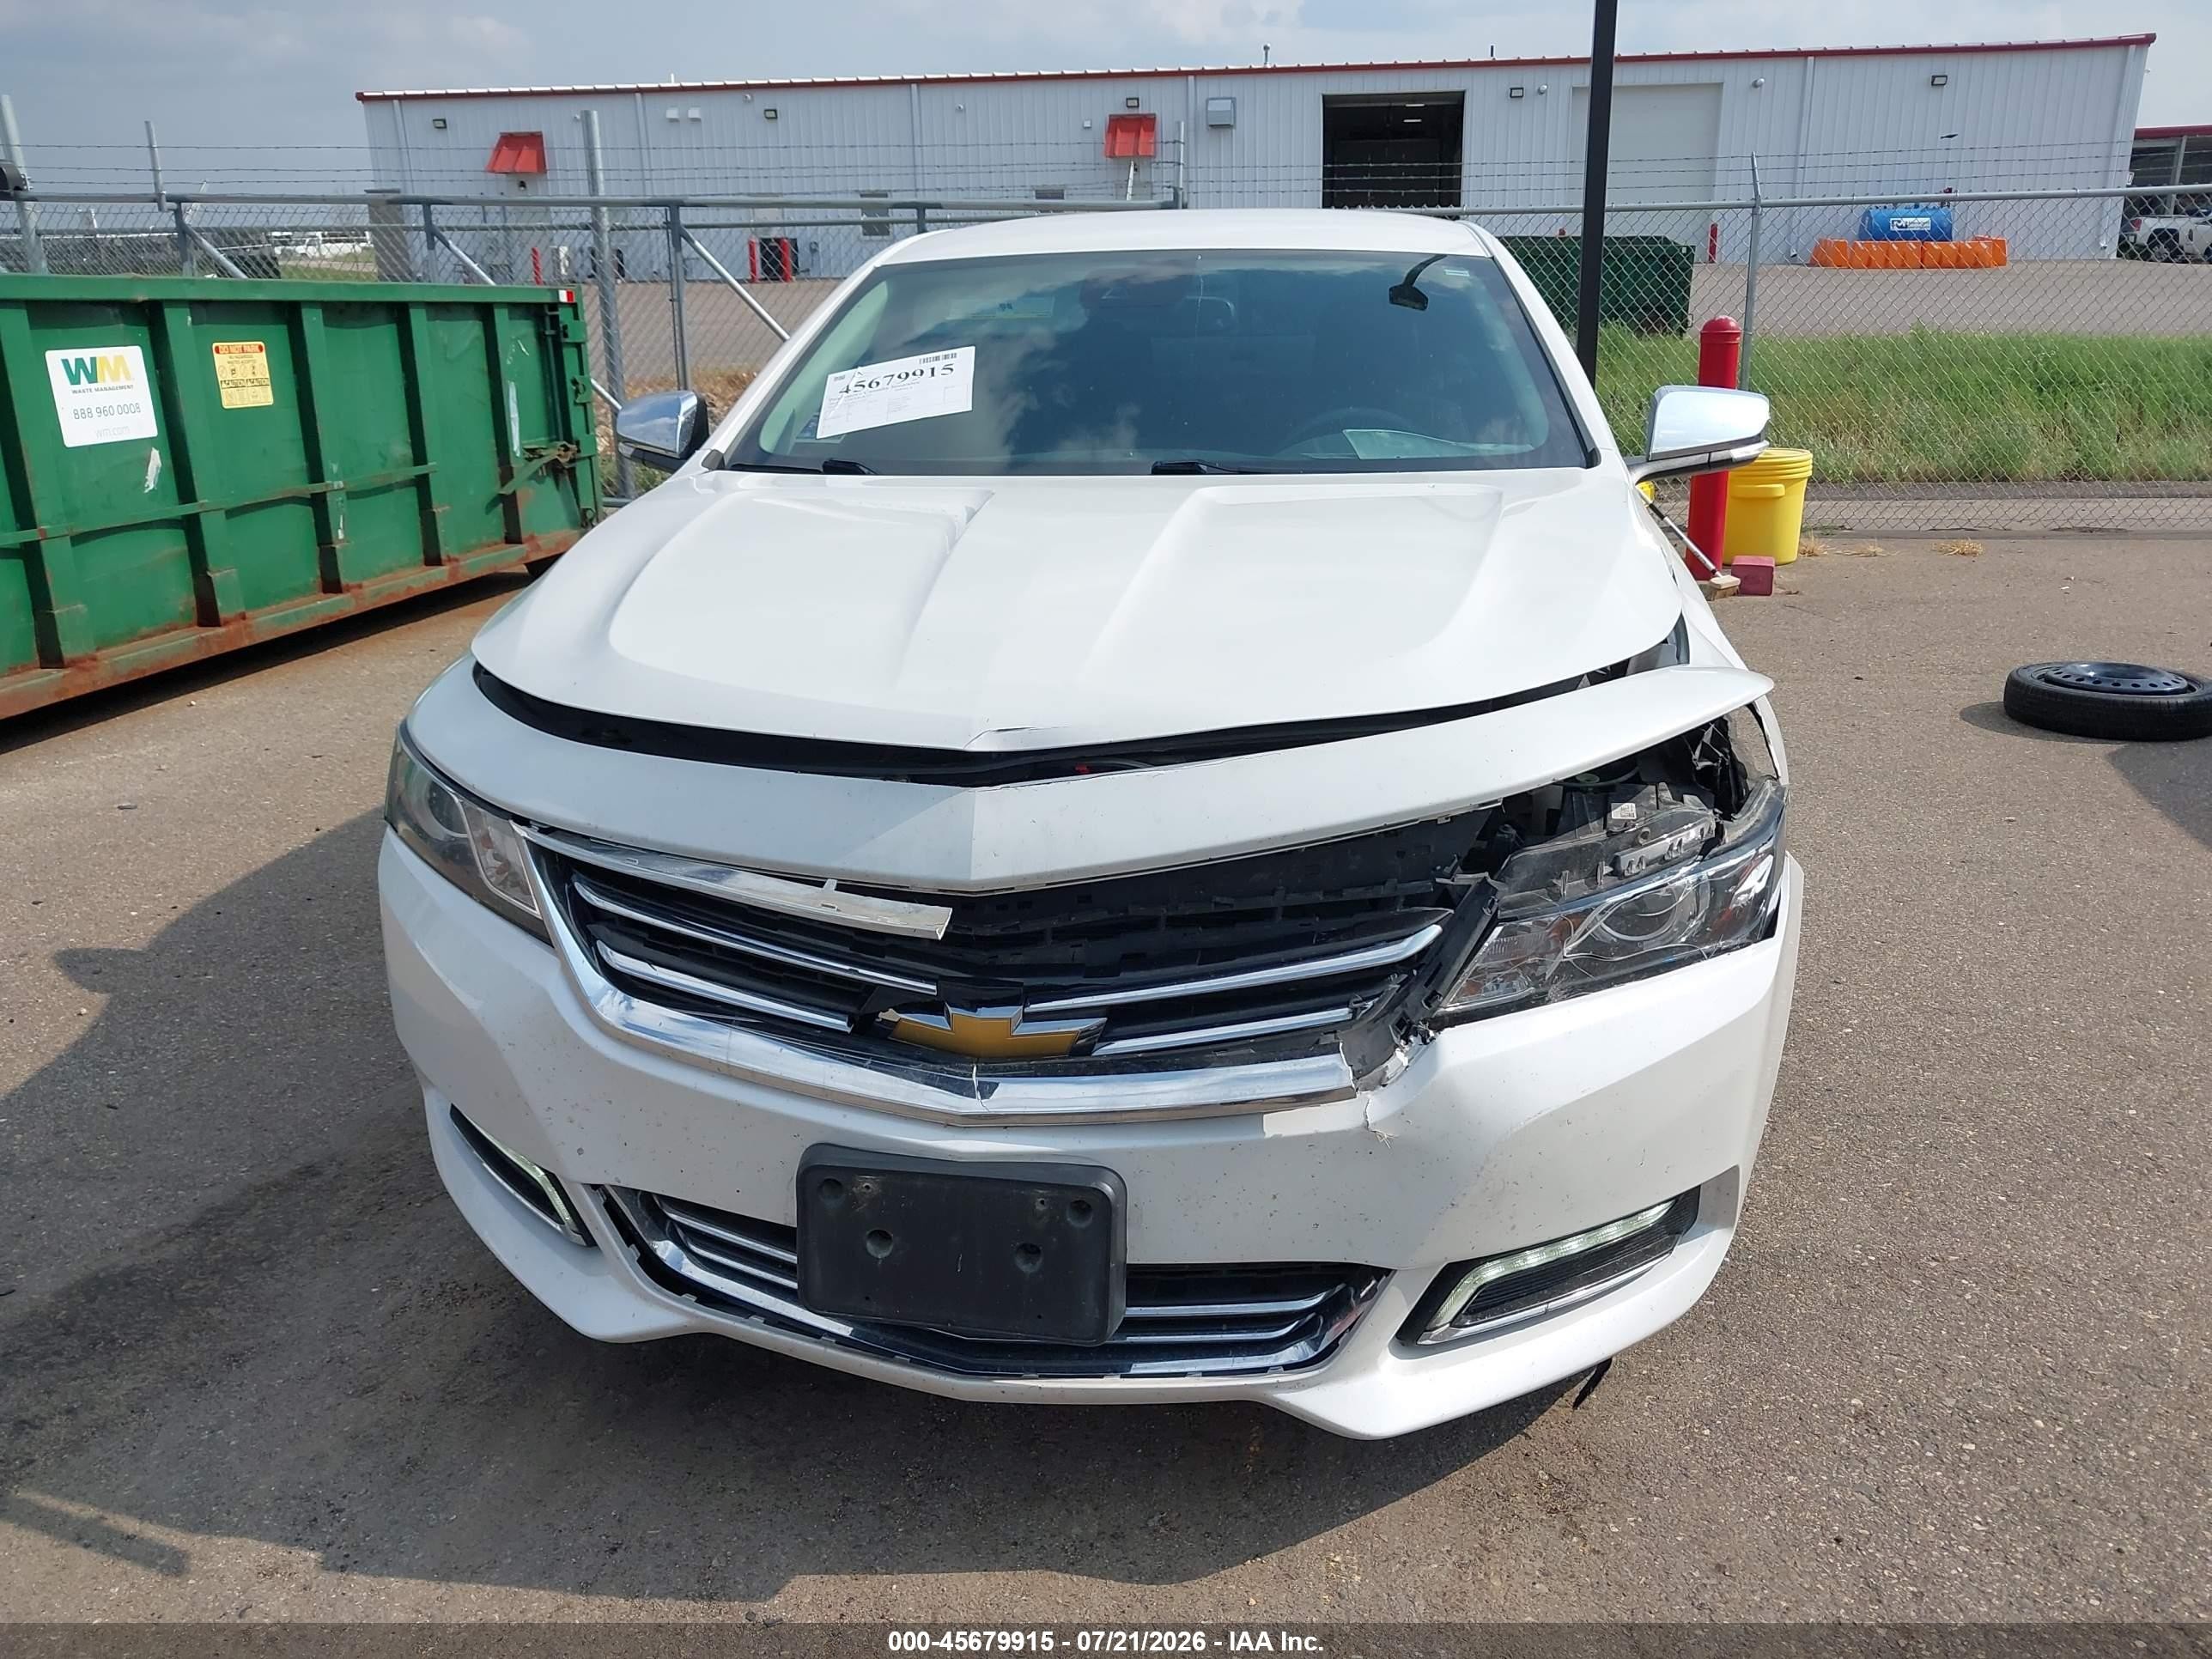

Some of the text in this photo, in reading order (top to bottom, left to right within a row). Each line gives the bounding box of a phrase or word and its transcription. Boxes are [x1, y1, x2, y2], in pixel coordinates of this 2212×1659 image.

[61, 355, 131, 386] WM
[839, 363, 956, 394] 45679915
[94, 384, 134, 392] MANAGEMENT
[73, 402, 142, 420] 888 960 0008
[95, 426, 131, 439] wm.com
